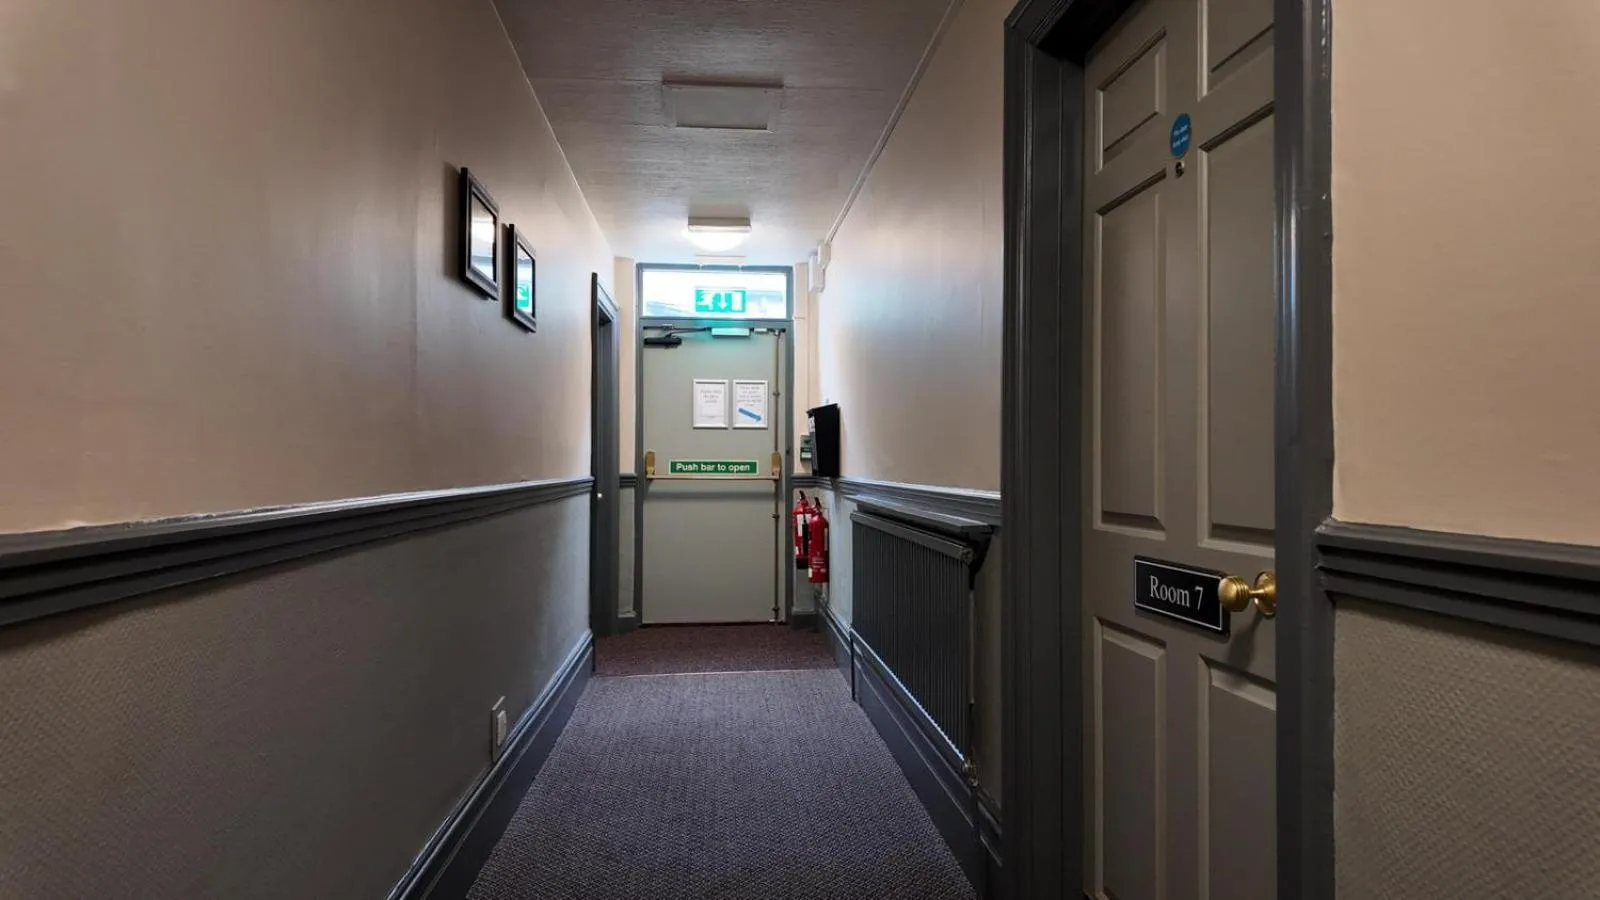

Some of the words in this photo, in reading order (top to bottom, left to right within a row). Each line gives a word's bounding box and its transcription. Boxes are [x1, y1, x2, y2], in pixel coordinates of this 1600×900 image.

[676, 463, 698, 471] Push
[701, 463, 715, 471] bar
[717, 463, 726, 471] to
[728, 465, 750, 473] open
[1150, 575, 1190, 608] Room
[1194, 586, 1204, 611] 7
